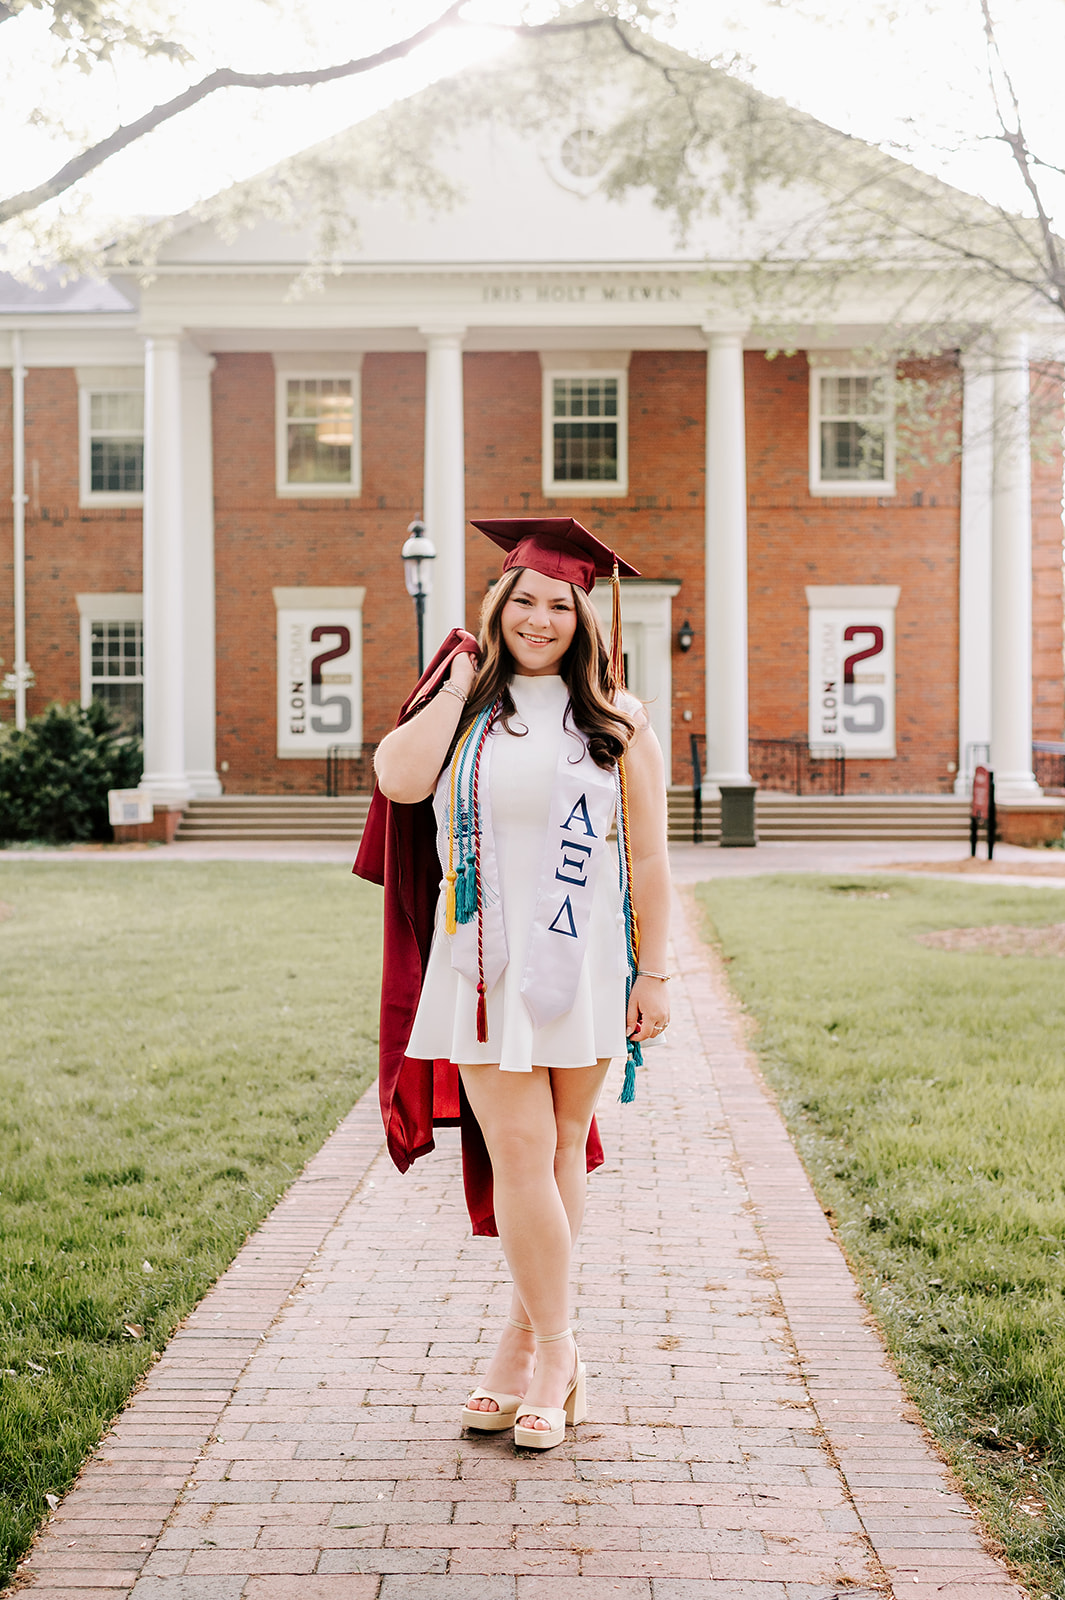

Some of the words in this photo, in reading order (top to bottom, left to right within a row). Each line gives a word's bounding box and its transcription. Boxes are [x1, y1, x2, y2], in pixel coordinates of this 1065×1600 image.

[482, 285, 523, 302] IRIS
[536, 285, 586, 302] HOLT
[290, 681, 305, 734] ELON
[823, 681, 838, 734] ELON
